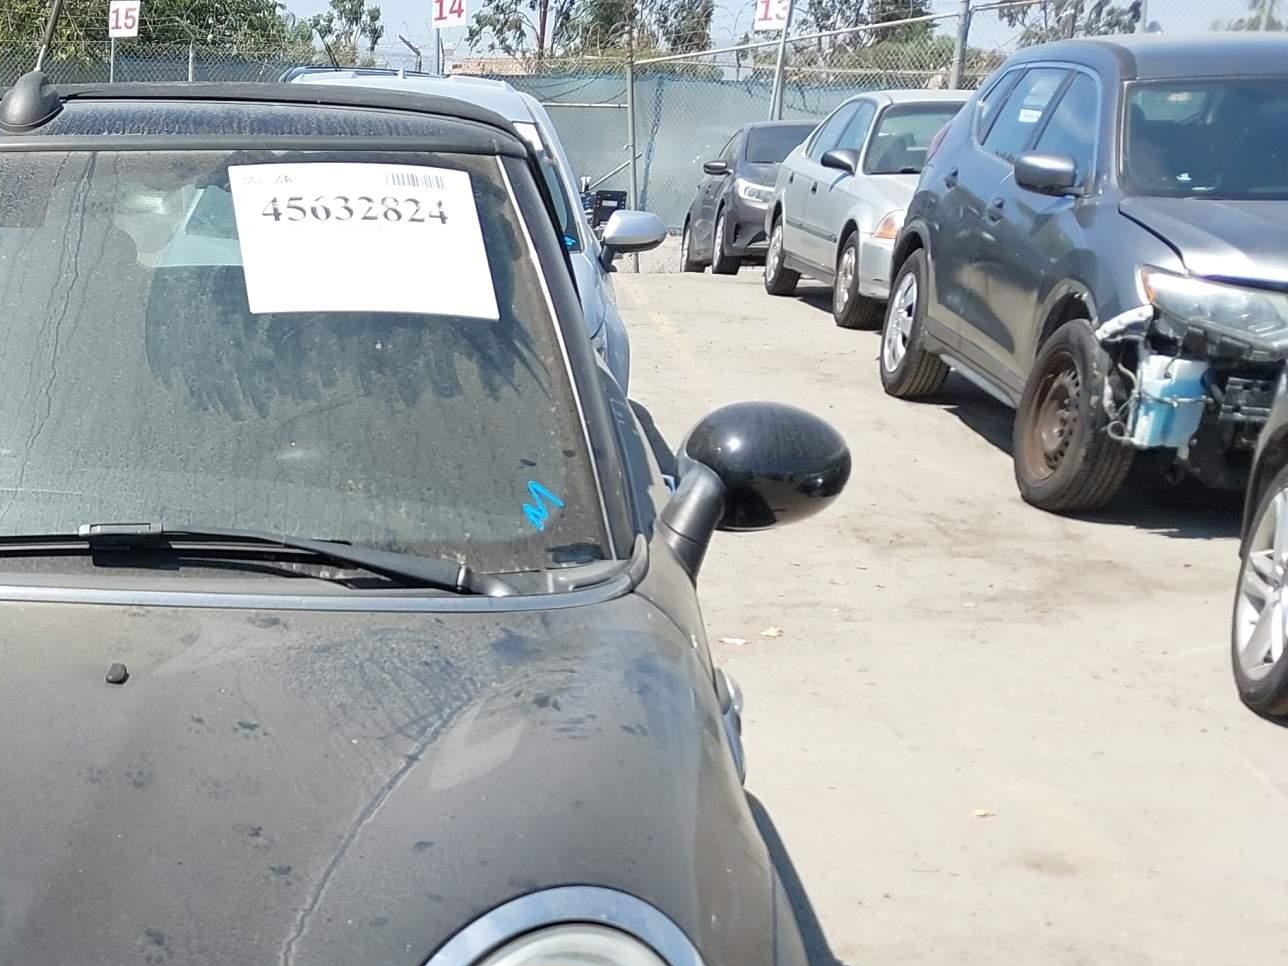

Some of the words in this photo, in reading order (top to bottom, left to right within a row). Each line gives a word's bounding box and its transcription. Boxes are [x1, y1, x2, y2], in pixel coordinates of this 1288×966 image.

[110, 7, 137, 30] 15
[434, 0, 465, 21] 14
[758, 0, 787, 21] 13
[261, 196, 449, 225] 45632824
